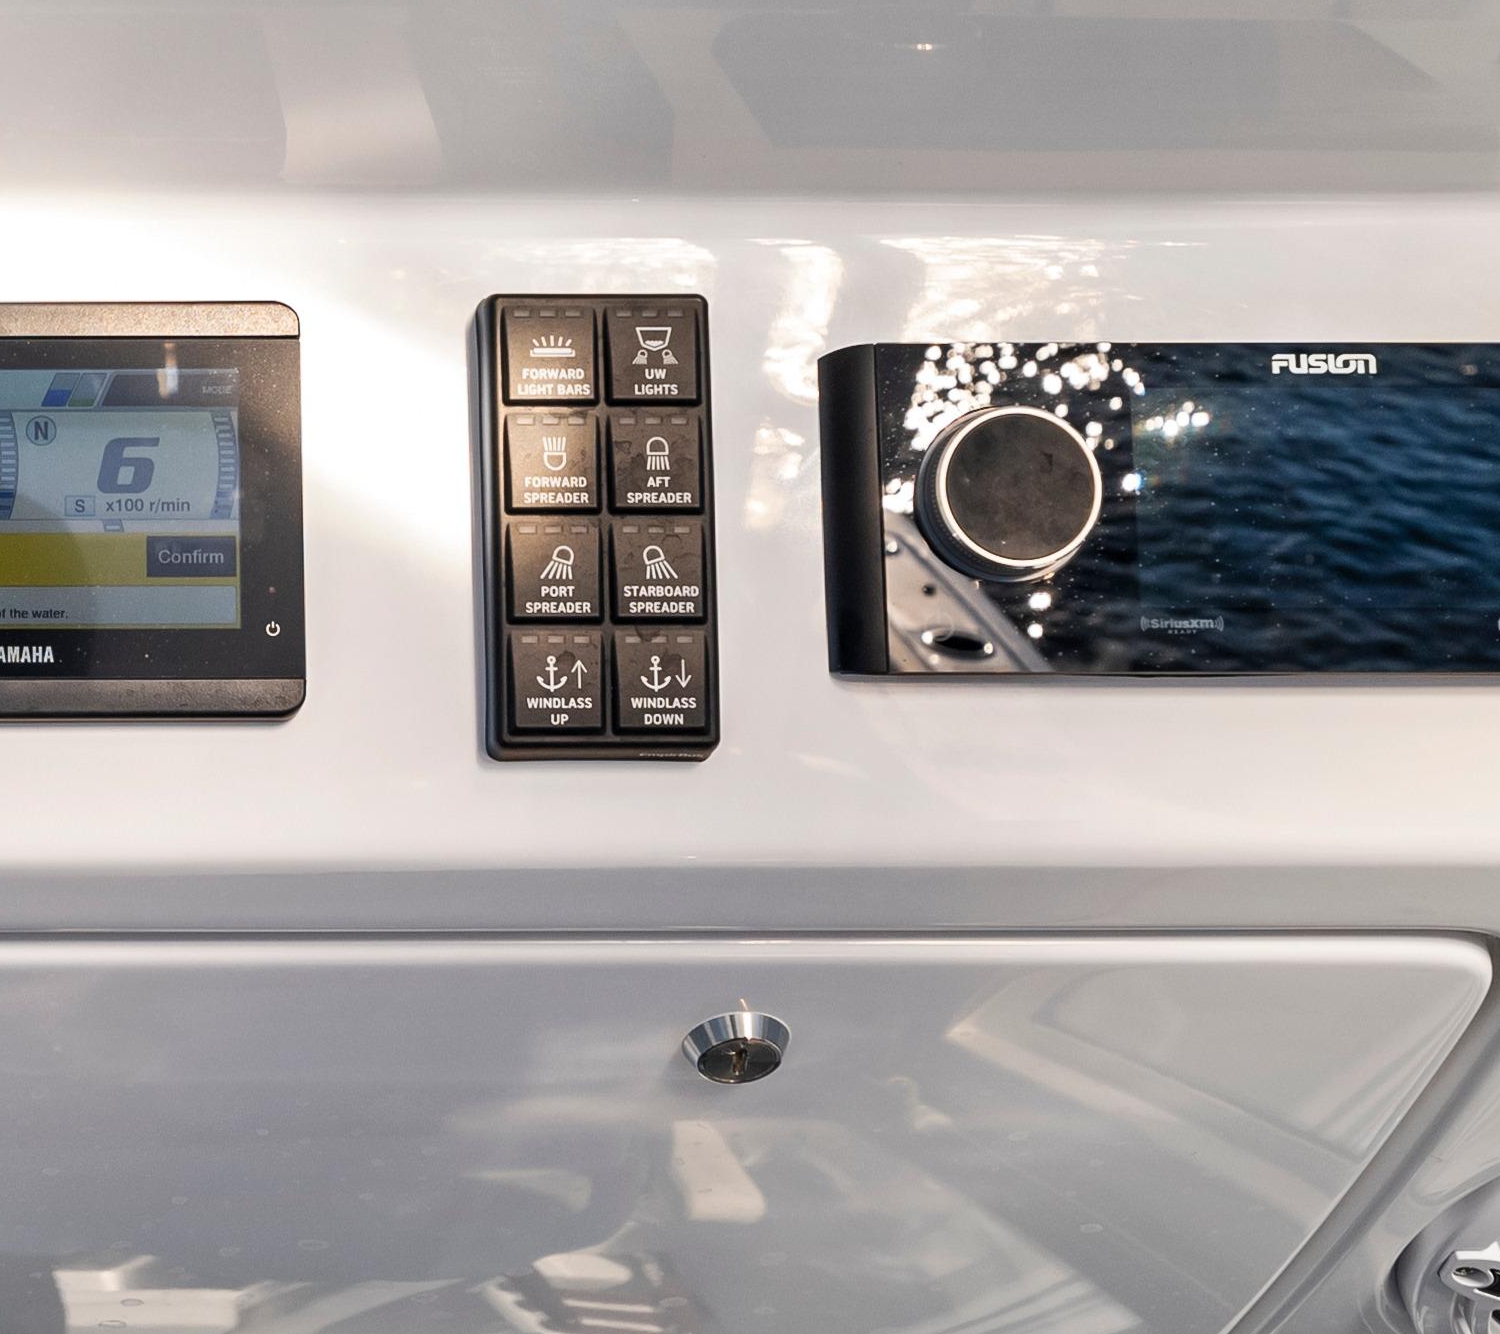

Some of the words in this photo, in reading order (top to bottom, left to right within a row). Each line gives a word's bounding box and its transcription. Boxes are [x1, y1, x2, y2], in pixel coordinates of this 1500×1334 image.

[1272, 354, 1377, 374] FUSION
[522, 368, 584, 379] FORWARD
[645, 369, 666, 379] UW
[518, 384, 553, 395] LIGHT
[557, 384, 590, 395] BARS
[635, 384, 678, 395] LIGHTS
[34, 421, 49, 440] N
[97, 437, 160, 494] 6
[525, 477, 587, 488] FORWARD
[647, 477, 670, 487] AFT
[524, 492, 589, 504] SPREADER
[627, 492, 692, 504] SPREADER
[75, 499, 85, 513] S
[106, 499, 144, 512] x100
[150, 498, 190, 512] r/min
[158, 548, 224, 565] Confirm
[541, 586, 575, 597] PORT
[624, 586, 699, 597] STARBOARD
[526, 602, 591, 613] SPREADER
[629, 602, 695, 613] SPREADER
[9, 609, 28, 618] the
[32, 609, 68, 619] water.
[527, 698, 592, 709] WINDLASS
[631, 698, 696, 708] WINDLASS
[551, 714, 569, 725] UP
[644, 714, 684, 725] DOWN
